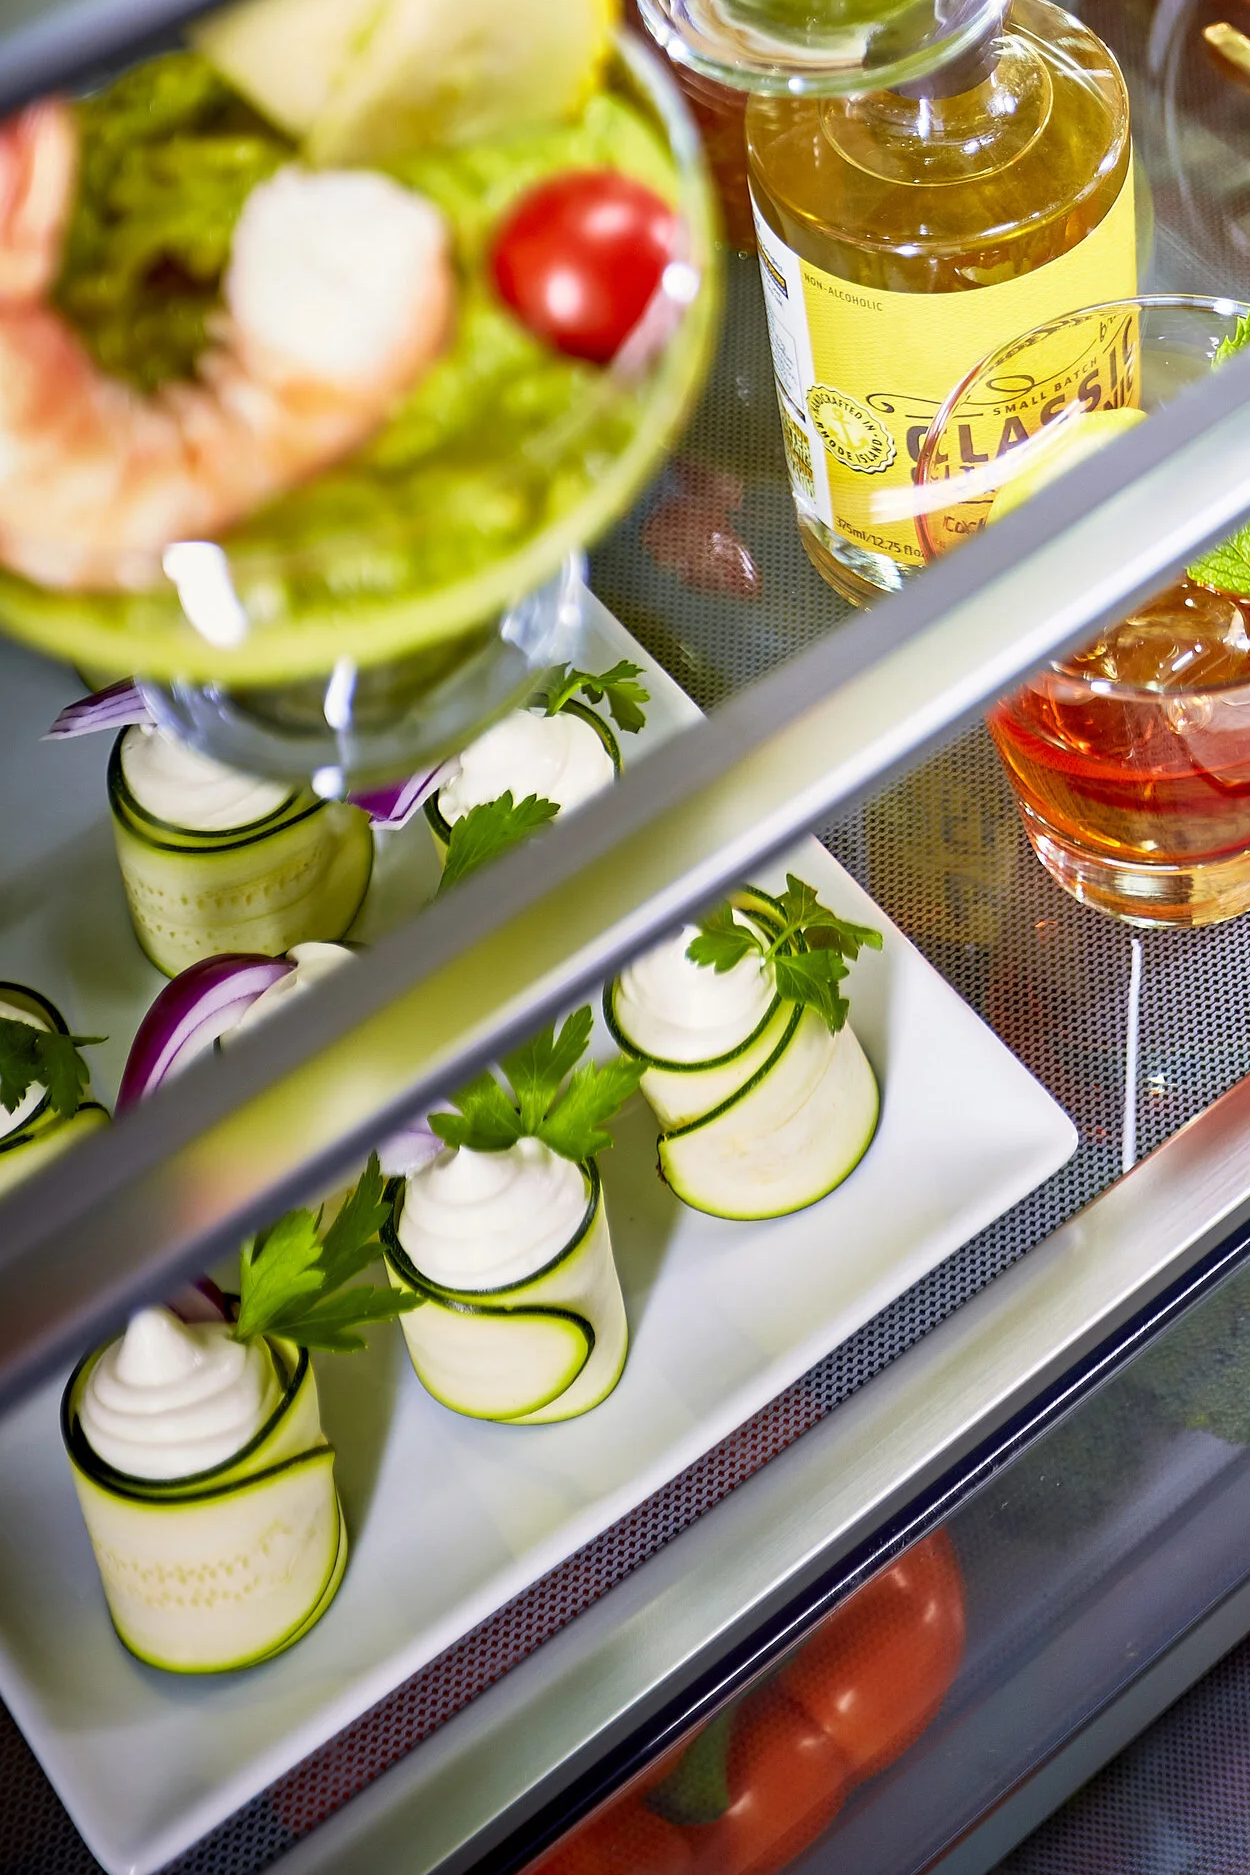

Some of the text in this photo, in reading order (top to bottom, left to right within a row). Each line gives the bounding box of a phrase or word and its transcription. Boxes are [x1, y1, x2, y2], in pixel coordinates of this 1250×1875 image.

[803, 272, 884, 312] NON-ALCOHOLIC
[993, 357, 1098, 416] SMALL BATCH
[815, 421, 853, 461] RHODE
[854, 438, 883, 464] ISLAND
[862, 420, 876, 431] IN
